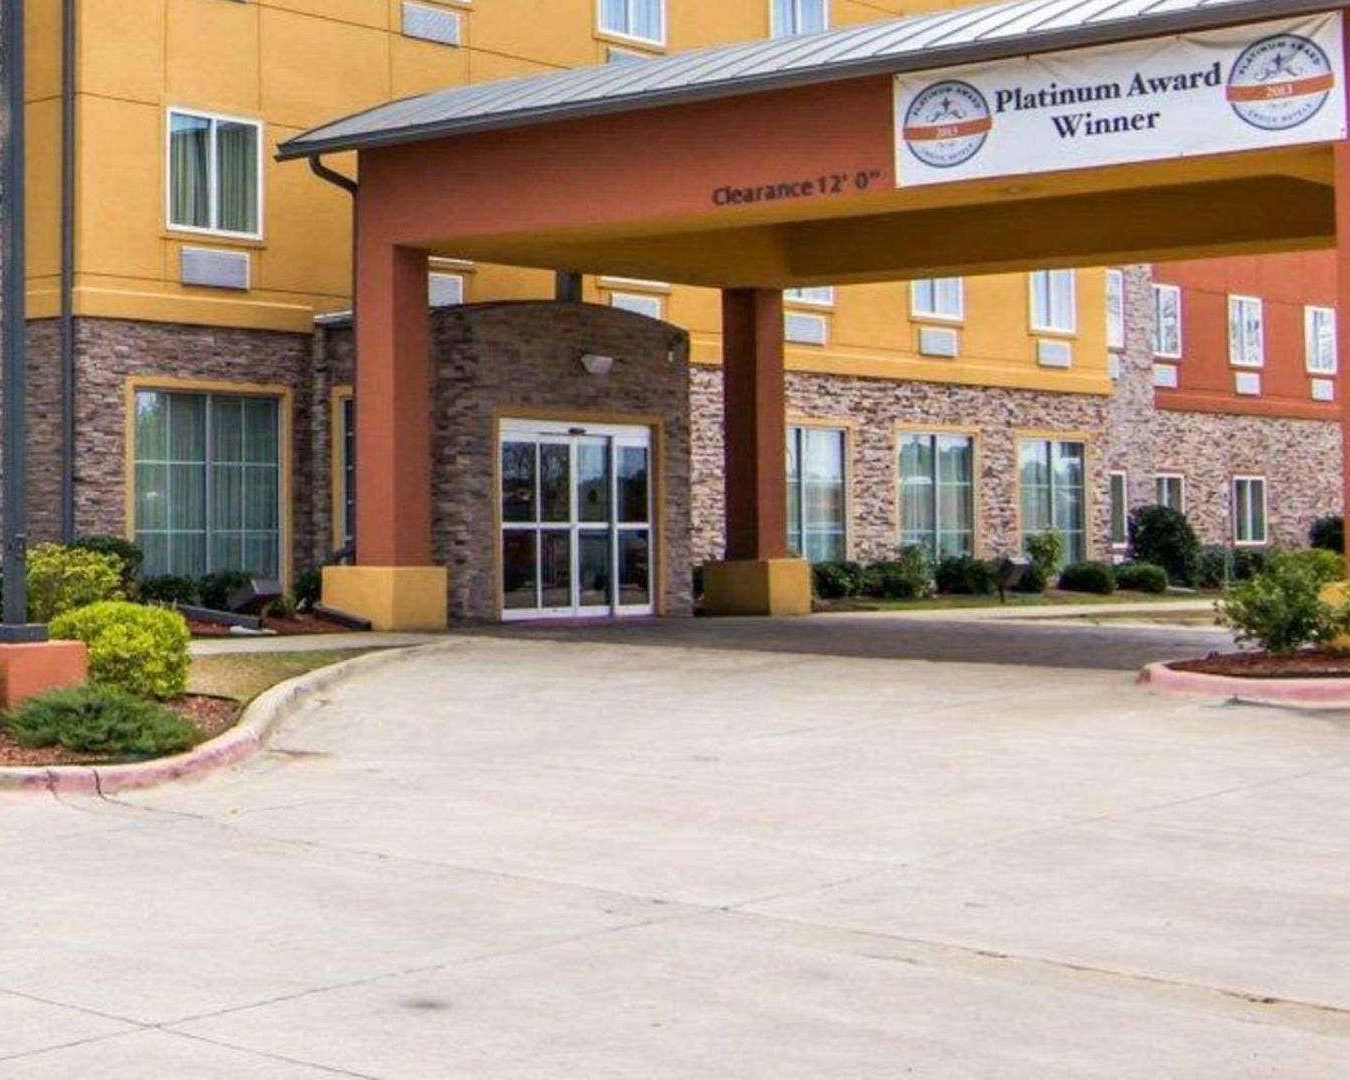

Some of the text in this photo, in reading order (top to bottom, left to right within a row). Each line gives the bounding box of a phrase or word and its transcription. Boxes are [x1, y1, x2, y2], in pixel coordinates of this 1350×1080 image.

[995, 61, 1222, 114] Platinum Award
[1051, 111, 1161, 140] Winner
[712, 179, 814, 206] Clearance
